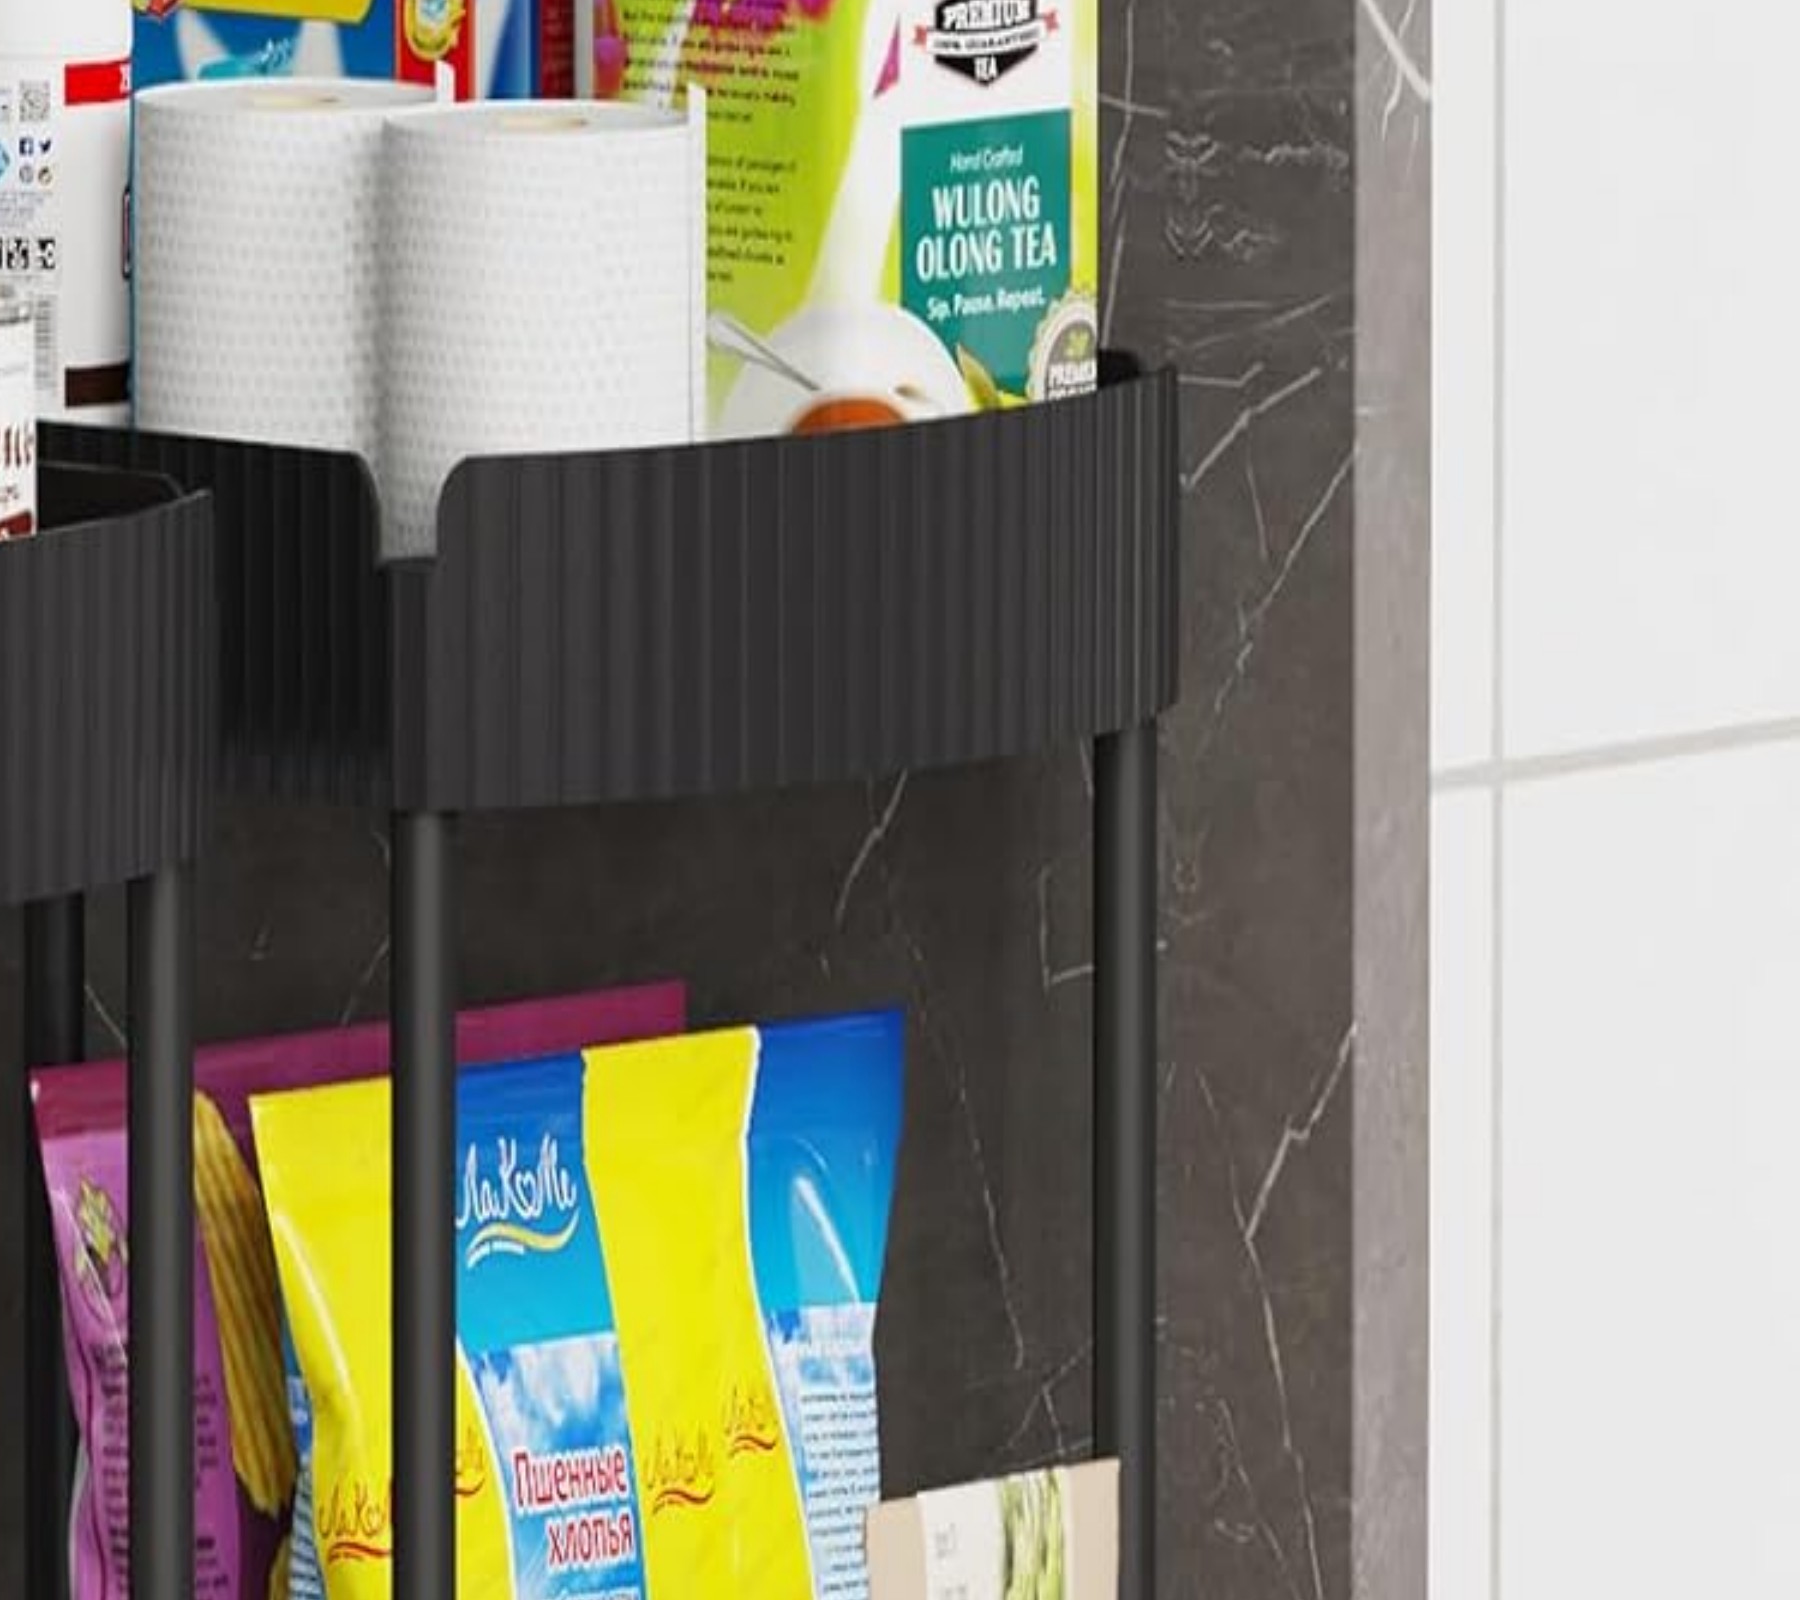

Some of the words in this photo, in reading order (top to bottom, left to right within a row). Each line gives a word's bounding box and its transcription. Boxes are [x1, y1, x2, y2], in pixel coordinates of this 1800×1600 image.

[931, 175, 1042, 230] WULONG
[916, 229, 1003, 283] OLONG
[1010, 222, 1058, 270] TEA
[514, 1448, 628, 1508] Пшенные
